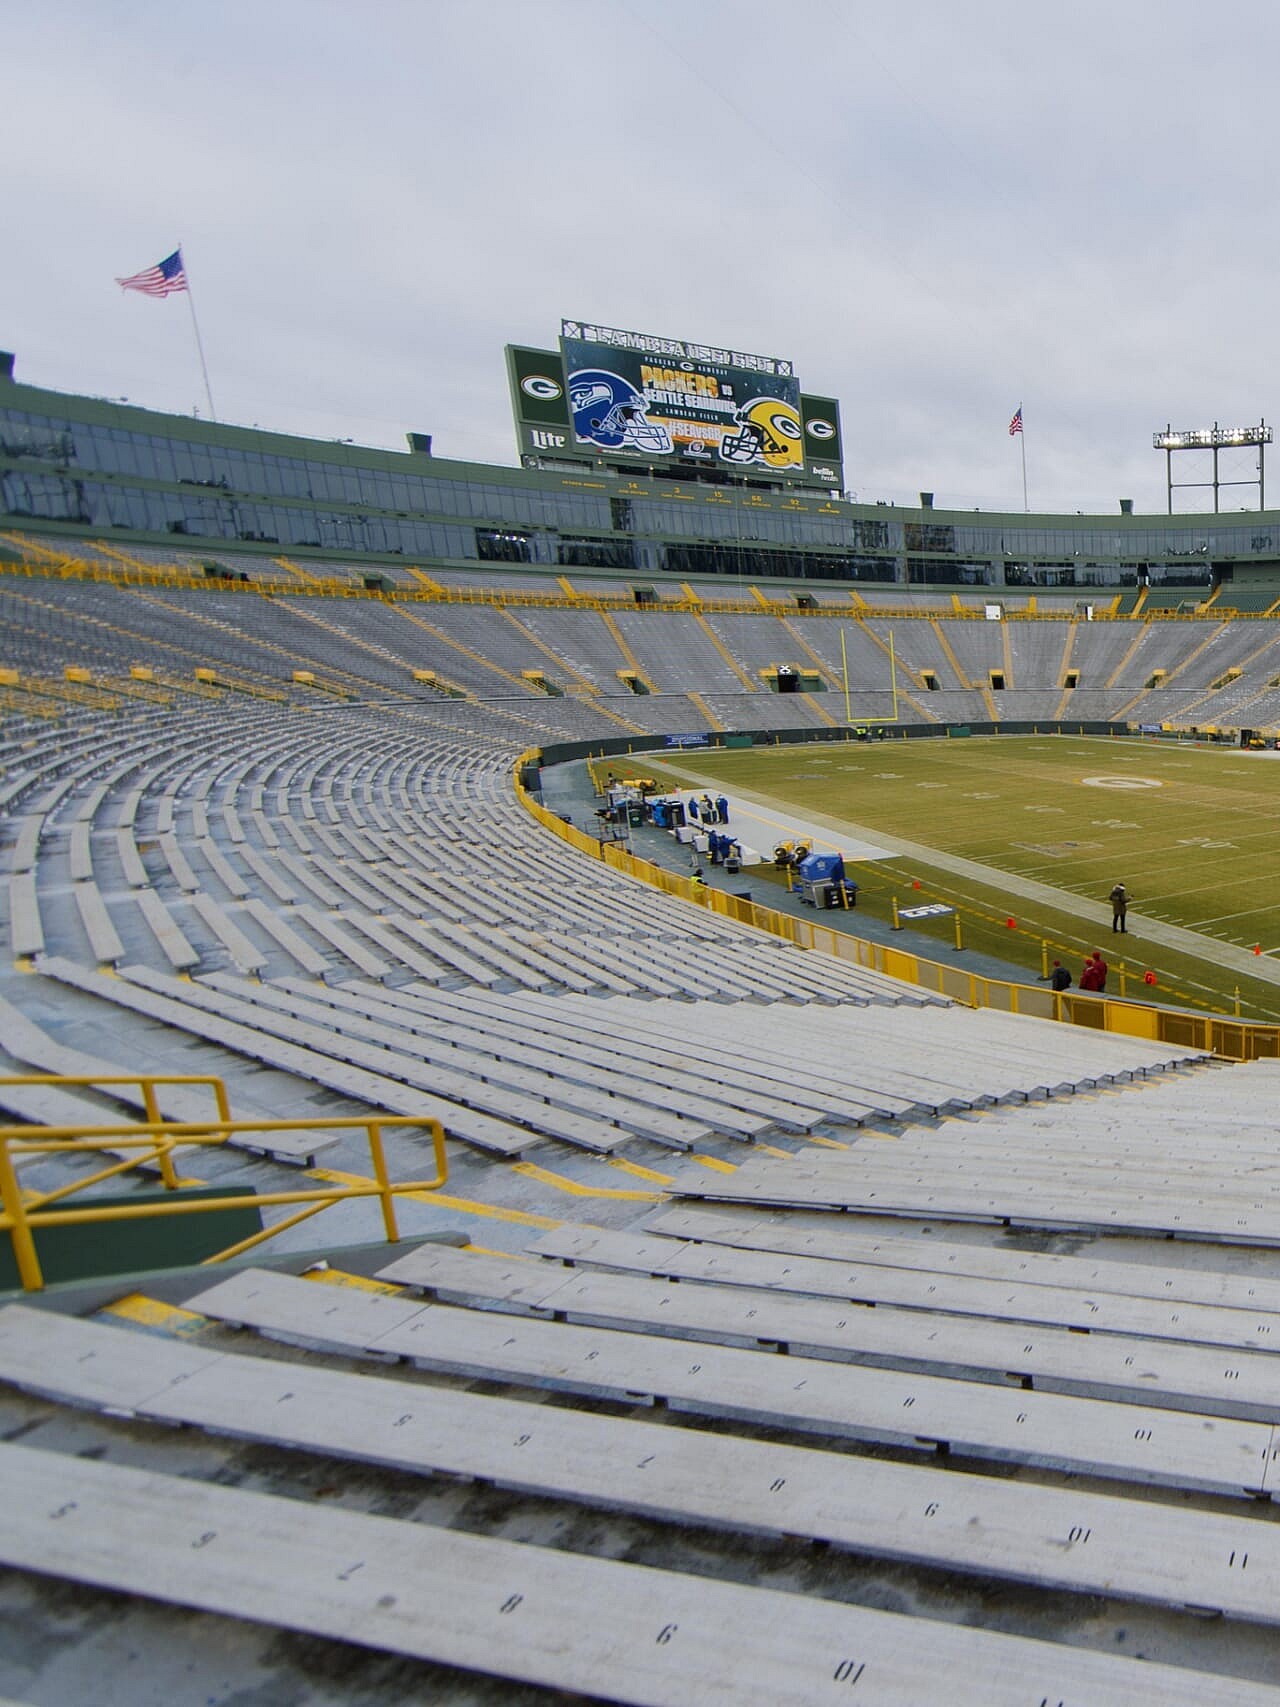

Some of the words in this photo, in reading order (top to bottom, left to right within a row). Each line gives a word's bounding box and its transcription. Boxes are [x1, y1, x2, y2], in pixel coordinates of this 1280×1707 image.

[640, 365, 719, 398] PACKERS
[643, 388, 684, 407] SEATTLE
[531, 429, 565, 449] Lite
[923, 1501, 941, 1518] 9
[1066, 1524, 1094, 1545] 10
[1227, 1550, 1250, 1570] 11
[654, 1623, 680, 1646] 9
[832, 1659, 867, 1686] 10
